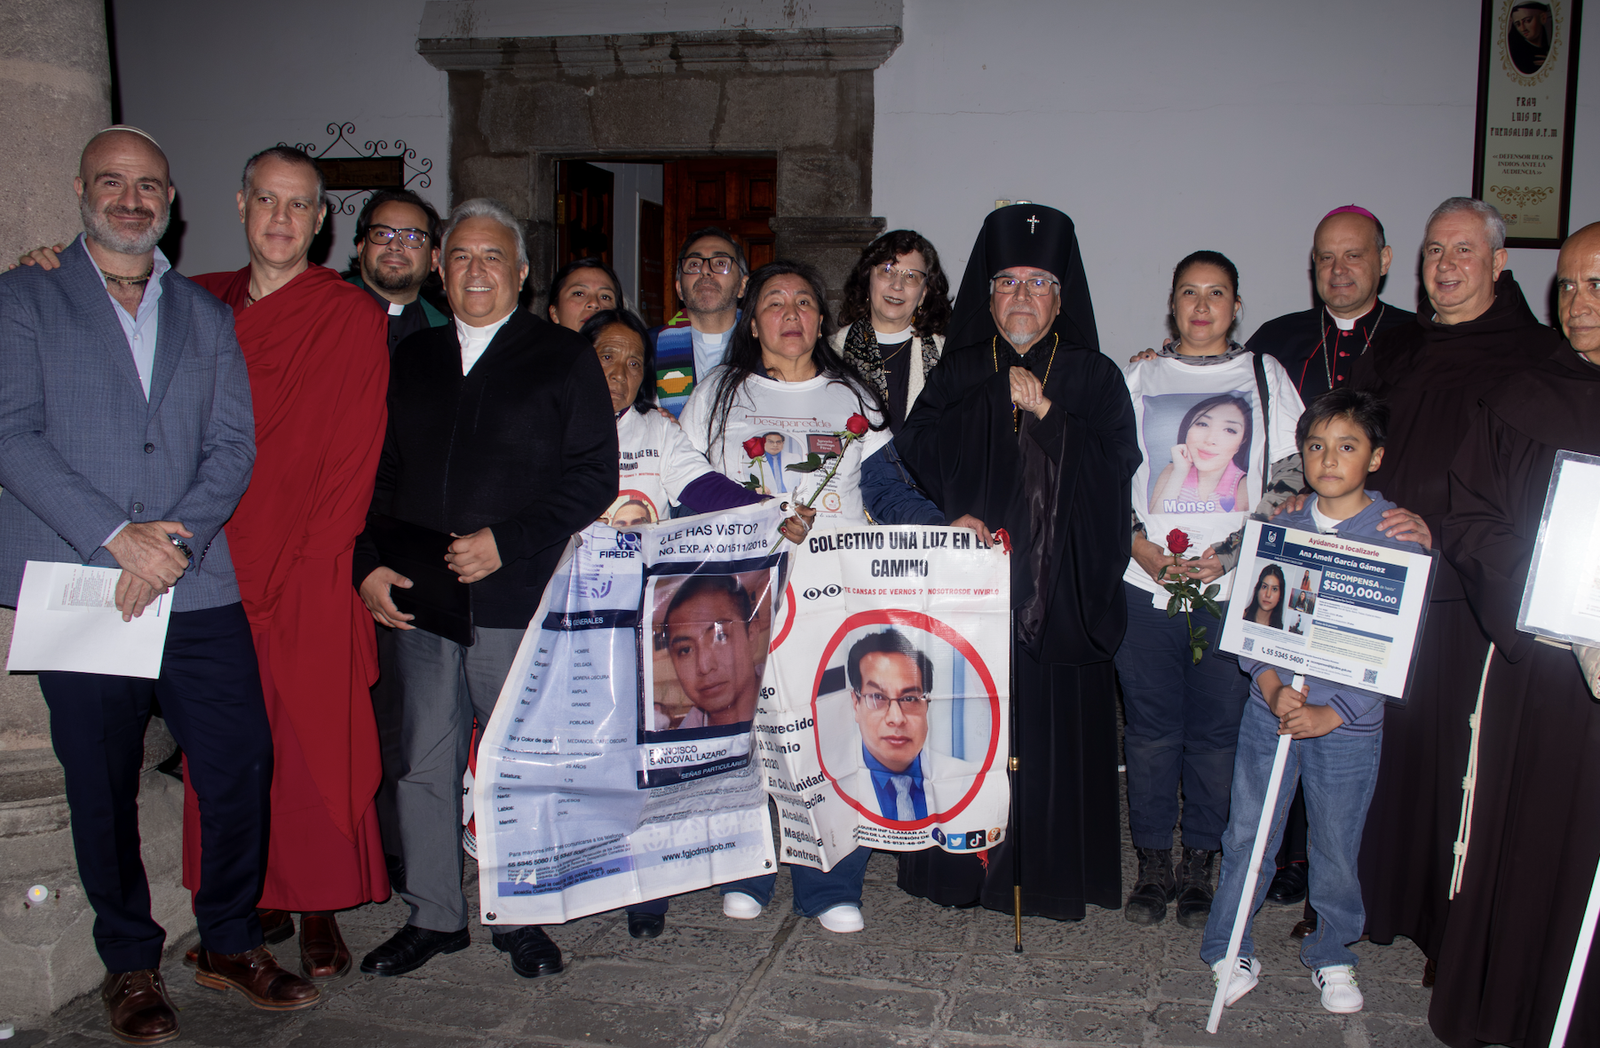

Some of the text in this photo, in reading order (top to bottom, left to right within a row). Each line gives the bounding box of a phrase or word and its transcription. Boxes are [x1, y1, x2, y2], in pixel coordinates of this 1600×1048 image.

[1516, 96, 1537, 106] FRAY
[1512, 112, 1542, 122] LUIS DE
[1490, 127, 1533, 137] FUENSALIDA
[623, 452, 633, 460] UNA
[635, 449, 644, 459] LUZ
[646, 449, 652, 457] EN
[654, 449, 660, 457] EL
[619, 462, 638, 471] AMINO
[1164, 500, 1215, 513] Monse
[660, 531, 682, 545] ¿LE
[686, 524, 712, 537] HAS
[809, 532, 884, 554] COLECTIVO
[889, 531, 918, 549] UNA
[922, 532, 948, 549] LUZ
[953, 532, 970, 549] EN
[659, 547, 676, 556] NO.
[680, 545, 700, 553] EXP.
[1308, 538, 1338, 549] Ayúdanos
[1345, 545, 1379, 557] localizarle
[871, 559, 928, 578] CAMINO
[1299, 550, 1312, 558] Ana
[1312, 552, 1333, 562] Amelí
[1334, 557, 1358, 568] García
[1359, 561, 1386, 574] Gámez
[1325, 570, 1379, 588] RECOMPENSA
[1323, 580, 1398, 604] $500,000.00
[573, 617, 603, 626] GENERALES
[1274, 650, 1288, 660] 5345
[1289, 654, 1304, 664] 5400
[650, 749, 727, 765] SANDOVAL LAZARO
[681, 759, 747, 779] SEÑAS PARTICULARES
[768, 776, 777, 787] En
[790, 771, 825, 792] Unidad
